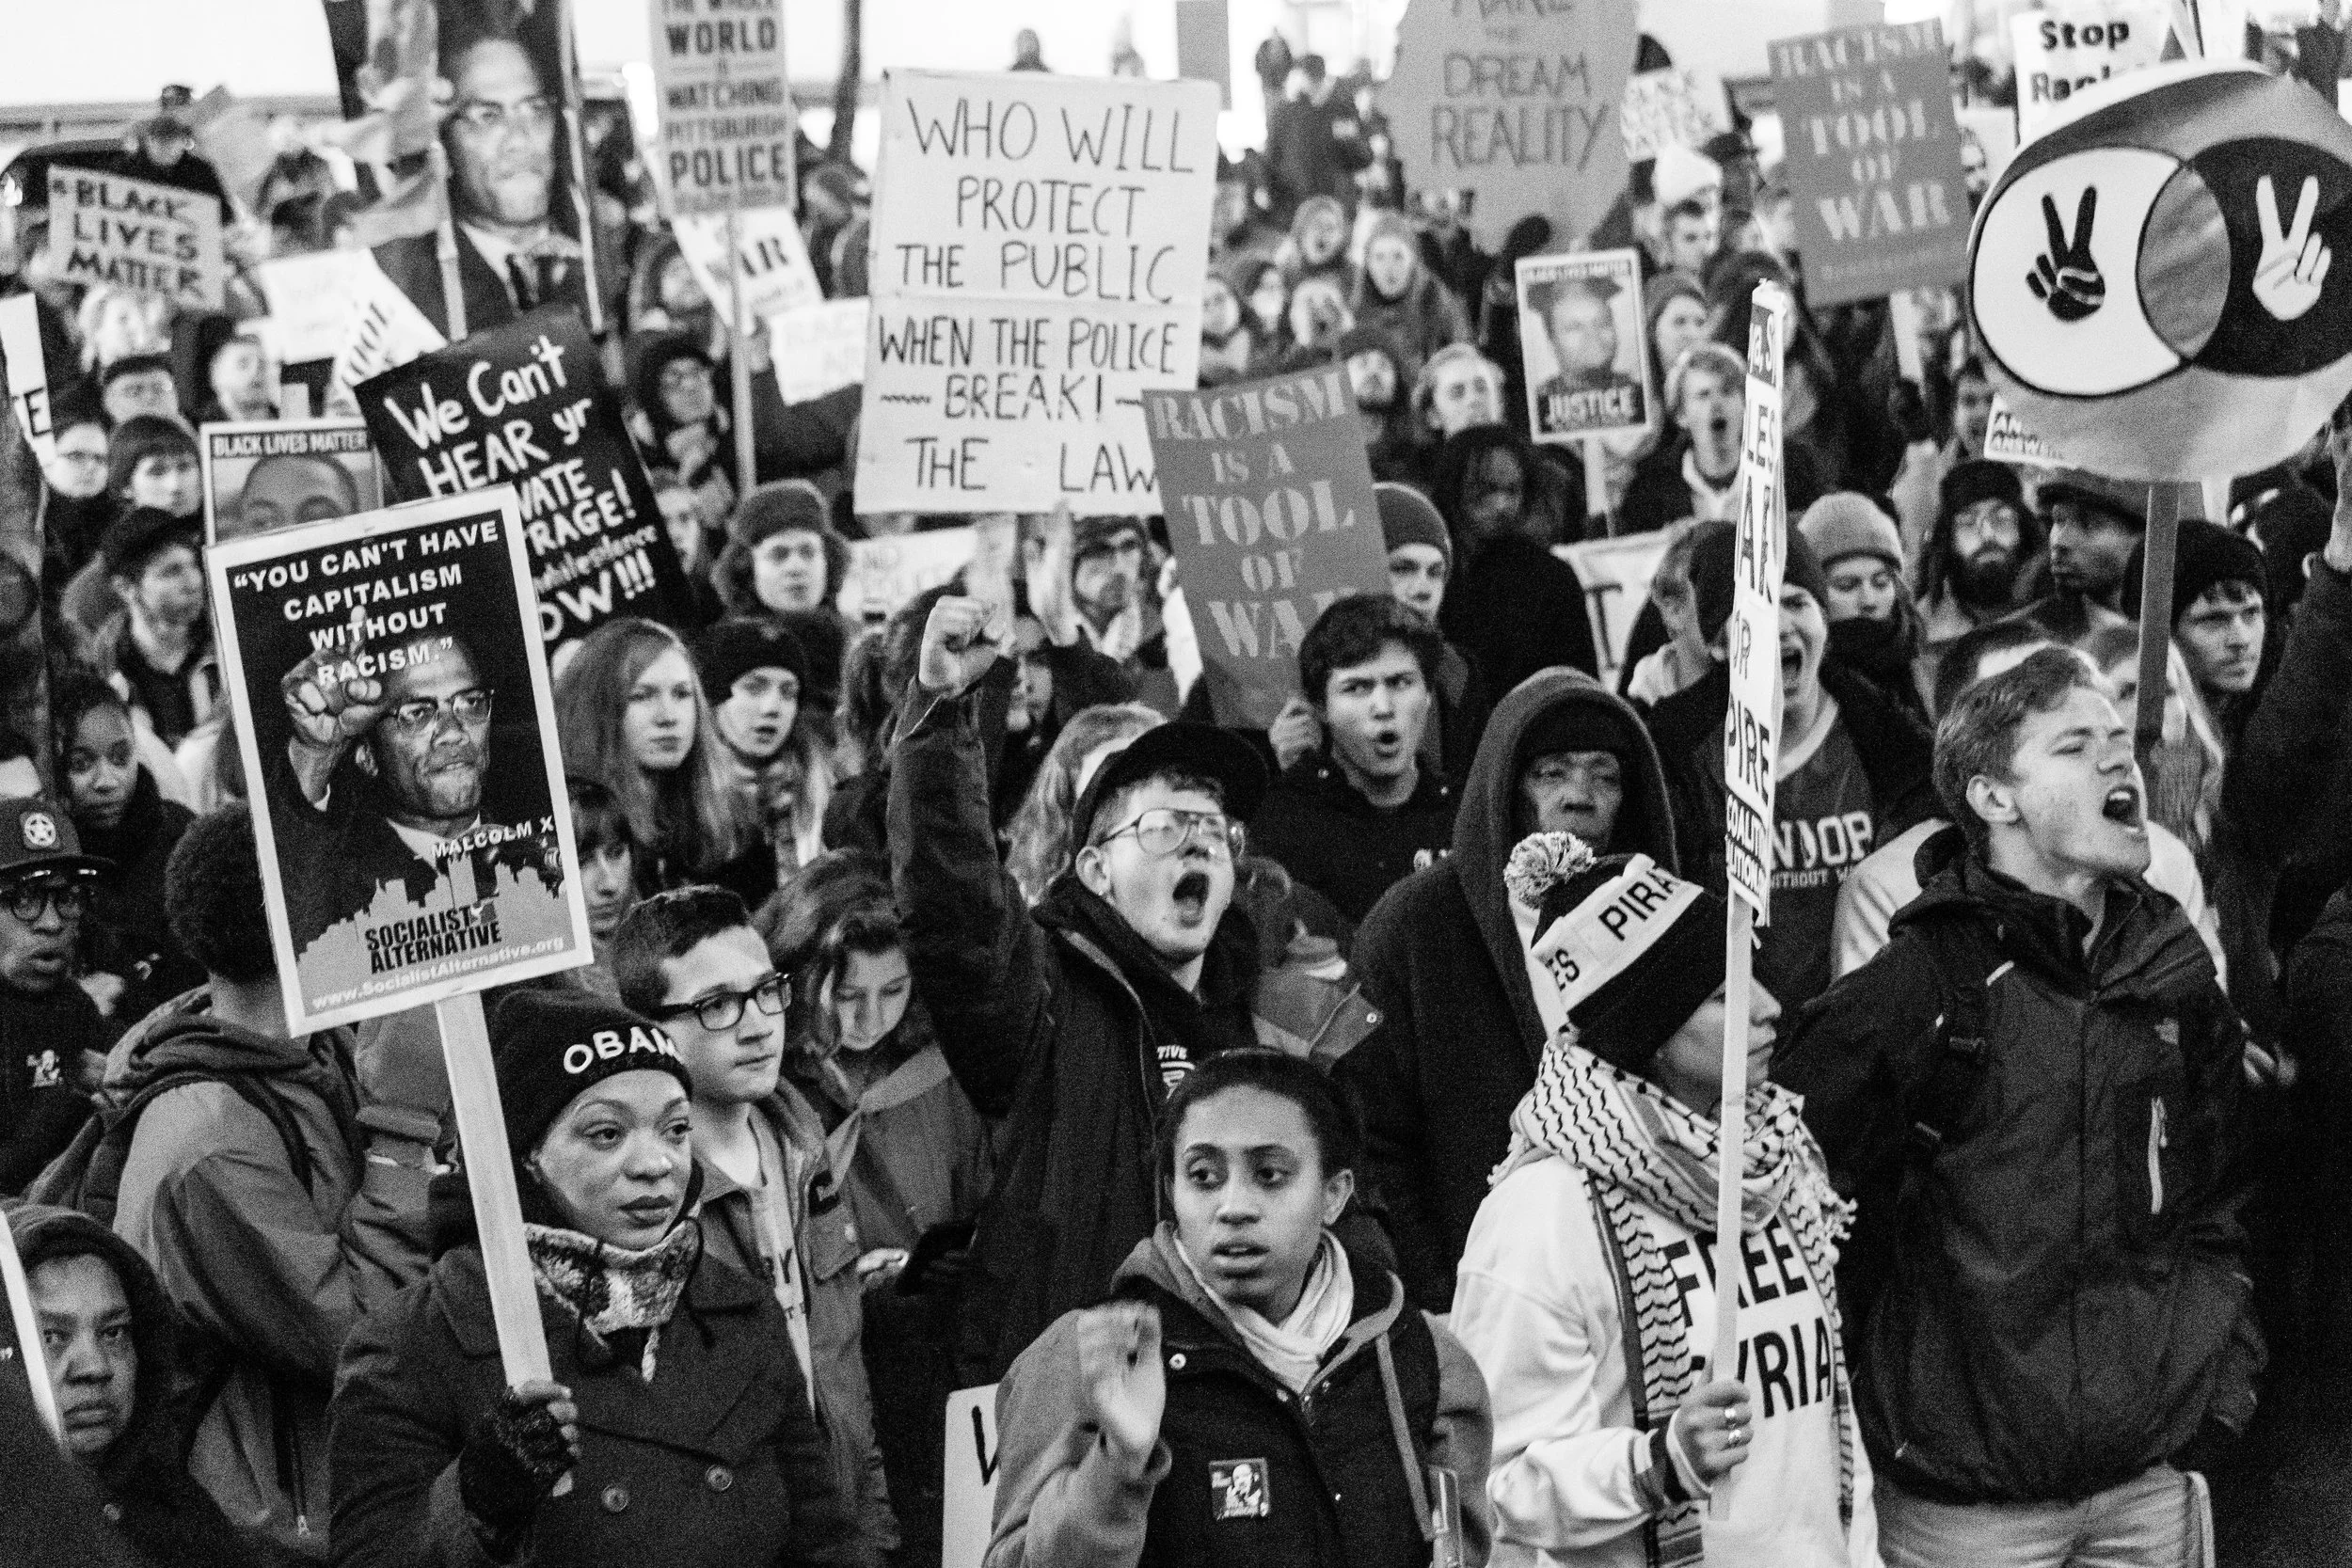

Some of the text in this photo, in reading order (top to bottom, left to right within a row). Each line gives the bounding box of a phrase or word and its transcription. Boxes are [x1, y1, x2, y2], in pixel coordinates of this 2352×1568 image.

[2041, 20, 2129, 51] Stop
[1443, 52, 1592, 99] DREAM
[907, 98, 1195, 174] WHO WILL
[1431, 103, 1609, 171] REALITY
[1801, 99, 1940, 156] TOOL
[669, 143, 787, 188] POLICE
[957, 176, 1145, 237] PROTECT
[1817, 183, 1951, 241] WAR
[73, 213, 199, 262] LIVES
[67, 248, 205, 299] MATTER
[896, 240, 1176, 304] THE PUBLIC
[878, 315, 973, 366] WHEN
[990, 317, 1050, 370] THE
[1067, 319, 1178, 374] POLICE
[384, 384, 469, 450] We
[469, 335, 565, 417] Can't
[1153, 373, 1345, 440] RACISM
[1546, 386, 1635, 425] JUSTICE
[215, 431, 368, 457] BLACK LIVES MATTER
[420, 399, 592, 499] HEAR yr
[905, 436, 1158, 492] THE LAW
[1211, 442, 1294, 483] IS A
[1182, 480, 1355, 545] TOOL
[321, 539, 408, 577] CAN'T
[420, 520, 499, 556] HAVE
[1242, 547, 1304, 592] OF
[284, 564, 462, 621] CAPITALISM
[310, 603, 447, 651] WITHOUT
[1209, 587, 1357, 657] WA
[431, 815, 554, 859] MALCOLM X
[365, 906, 470, 951] SOCIALIST
[371, 921, 502, 974] ALTERNATIVE
[312, 937, 564, 1011] www.SocialistAlternative.org
